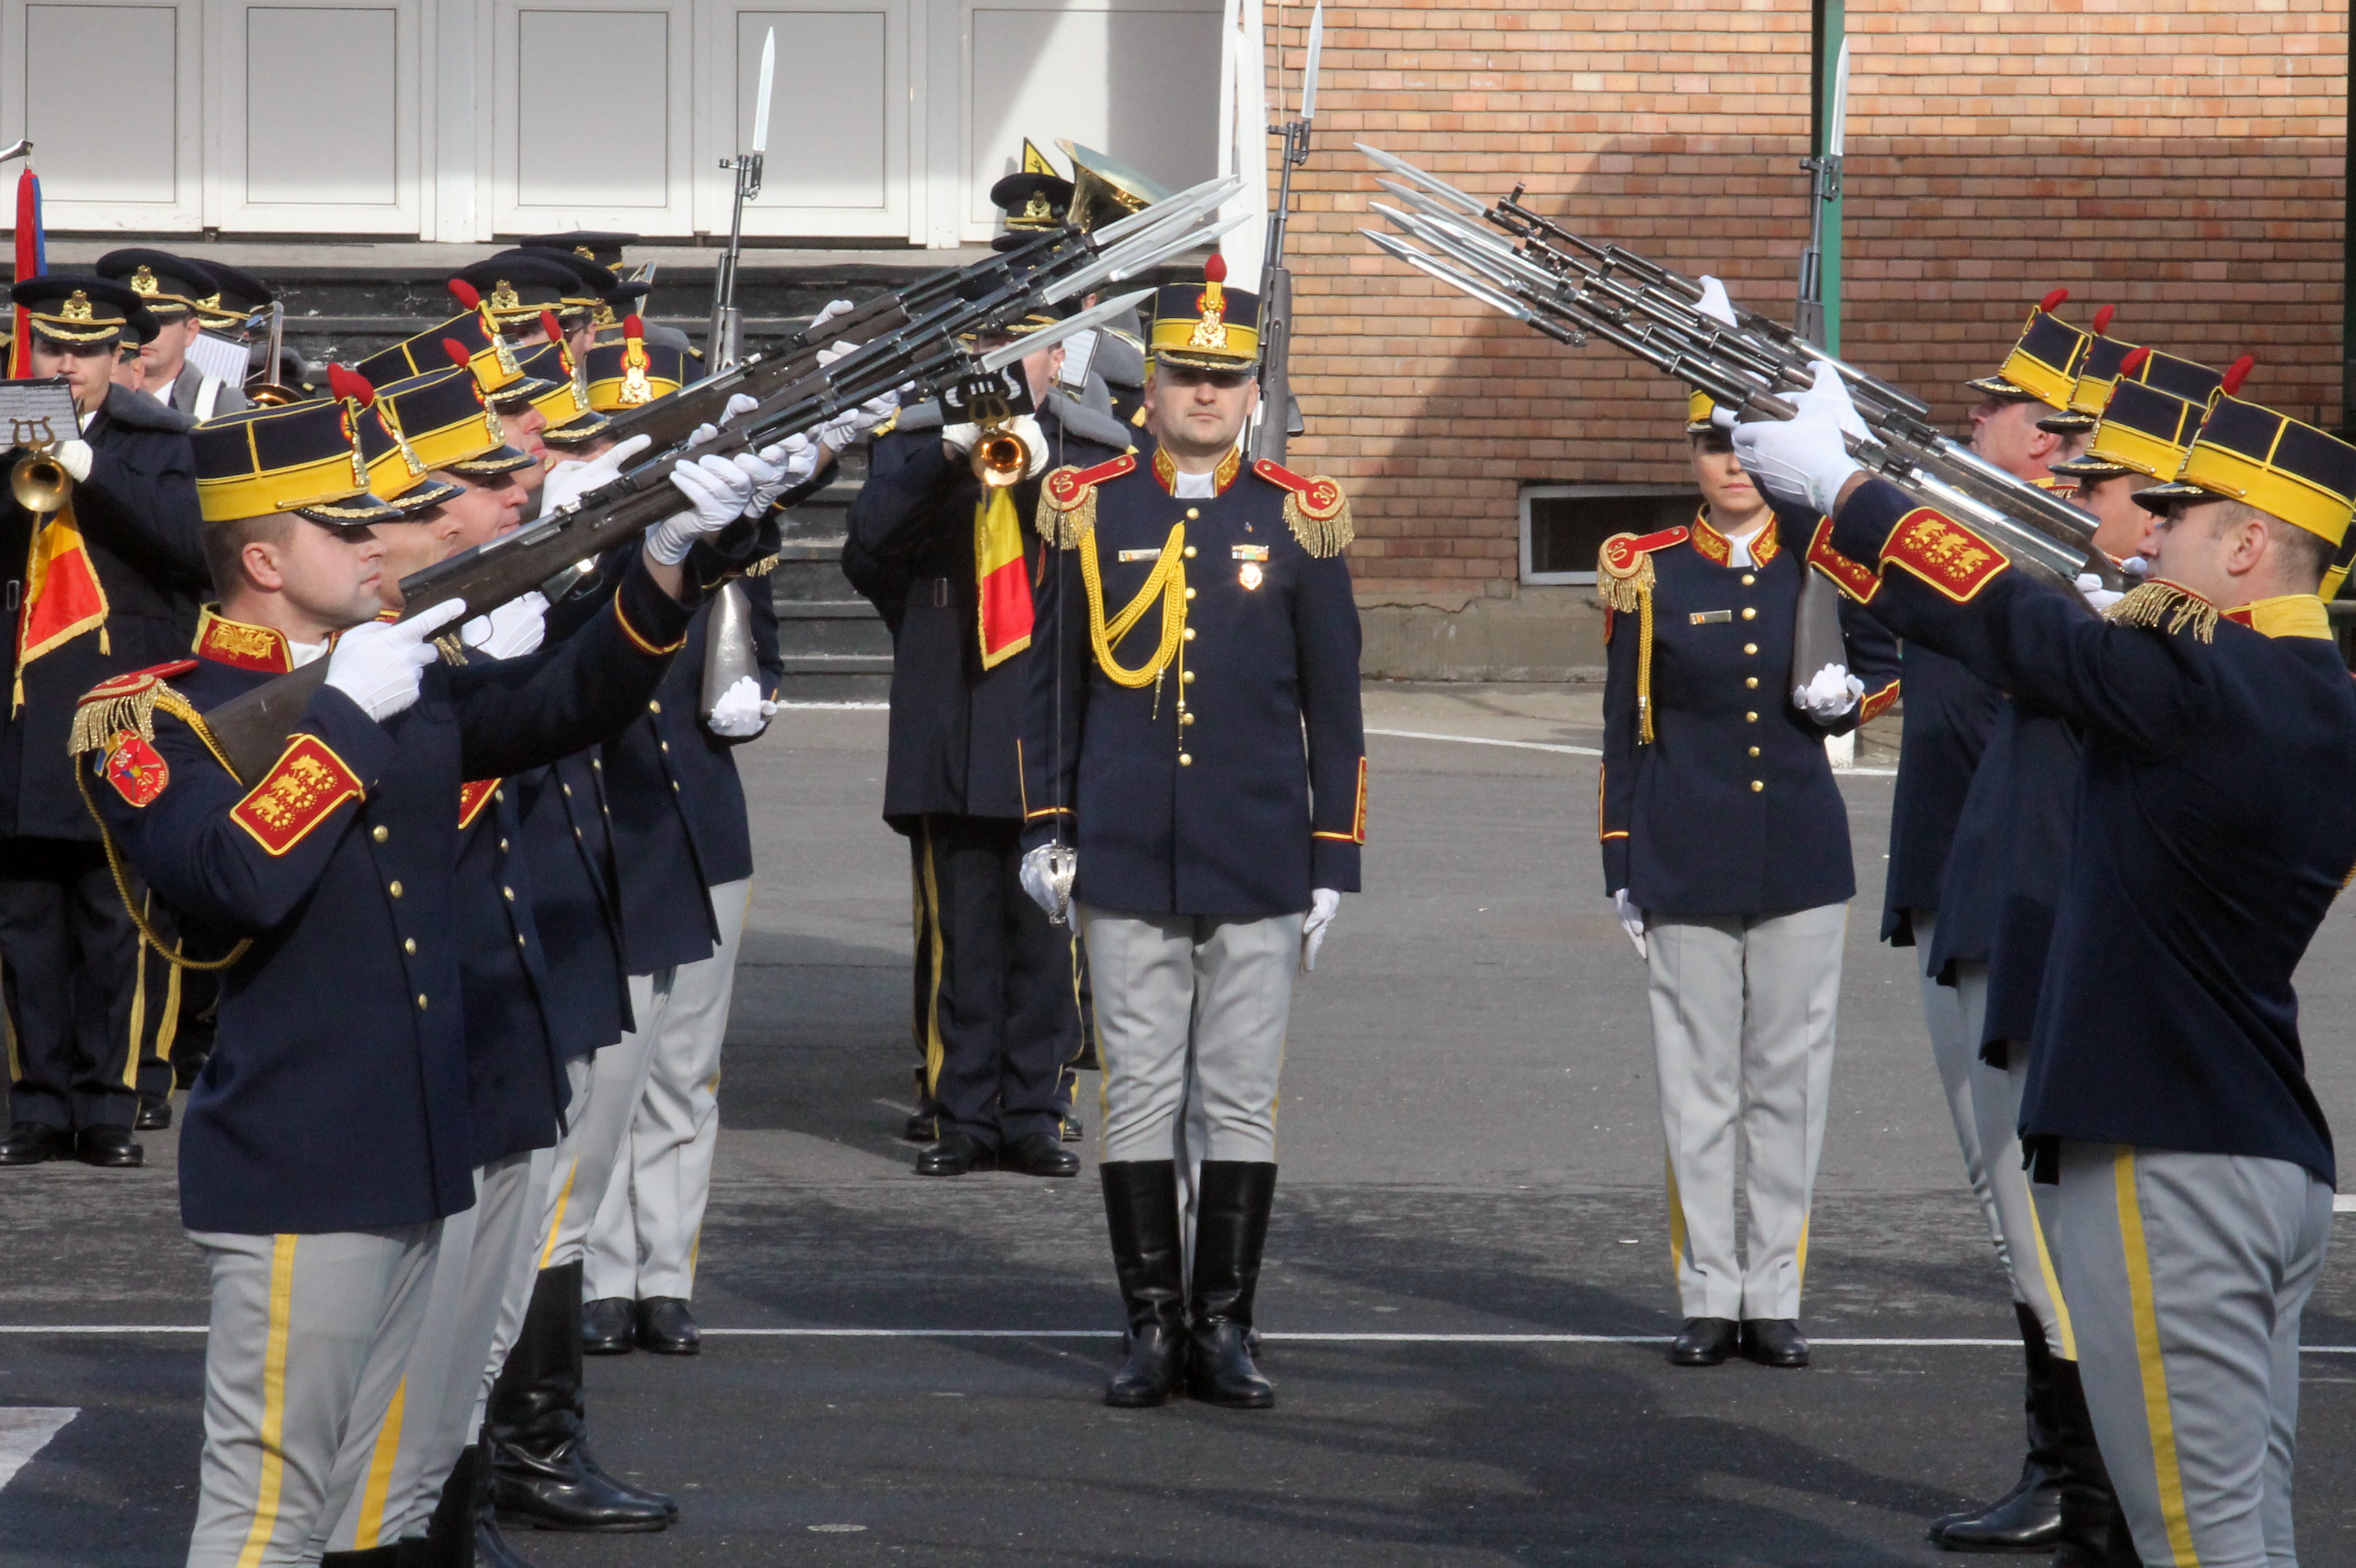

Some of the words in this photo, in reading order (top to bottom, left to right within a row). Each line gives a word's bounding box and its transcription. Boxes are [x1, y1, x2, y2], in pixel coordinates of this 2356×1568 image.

[1313, 485, 1335, 505] 30
[1608, 541, 1628, 562] 30
[137, 772, 154, 792] 30
